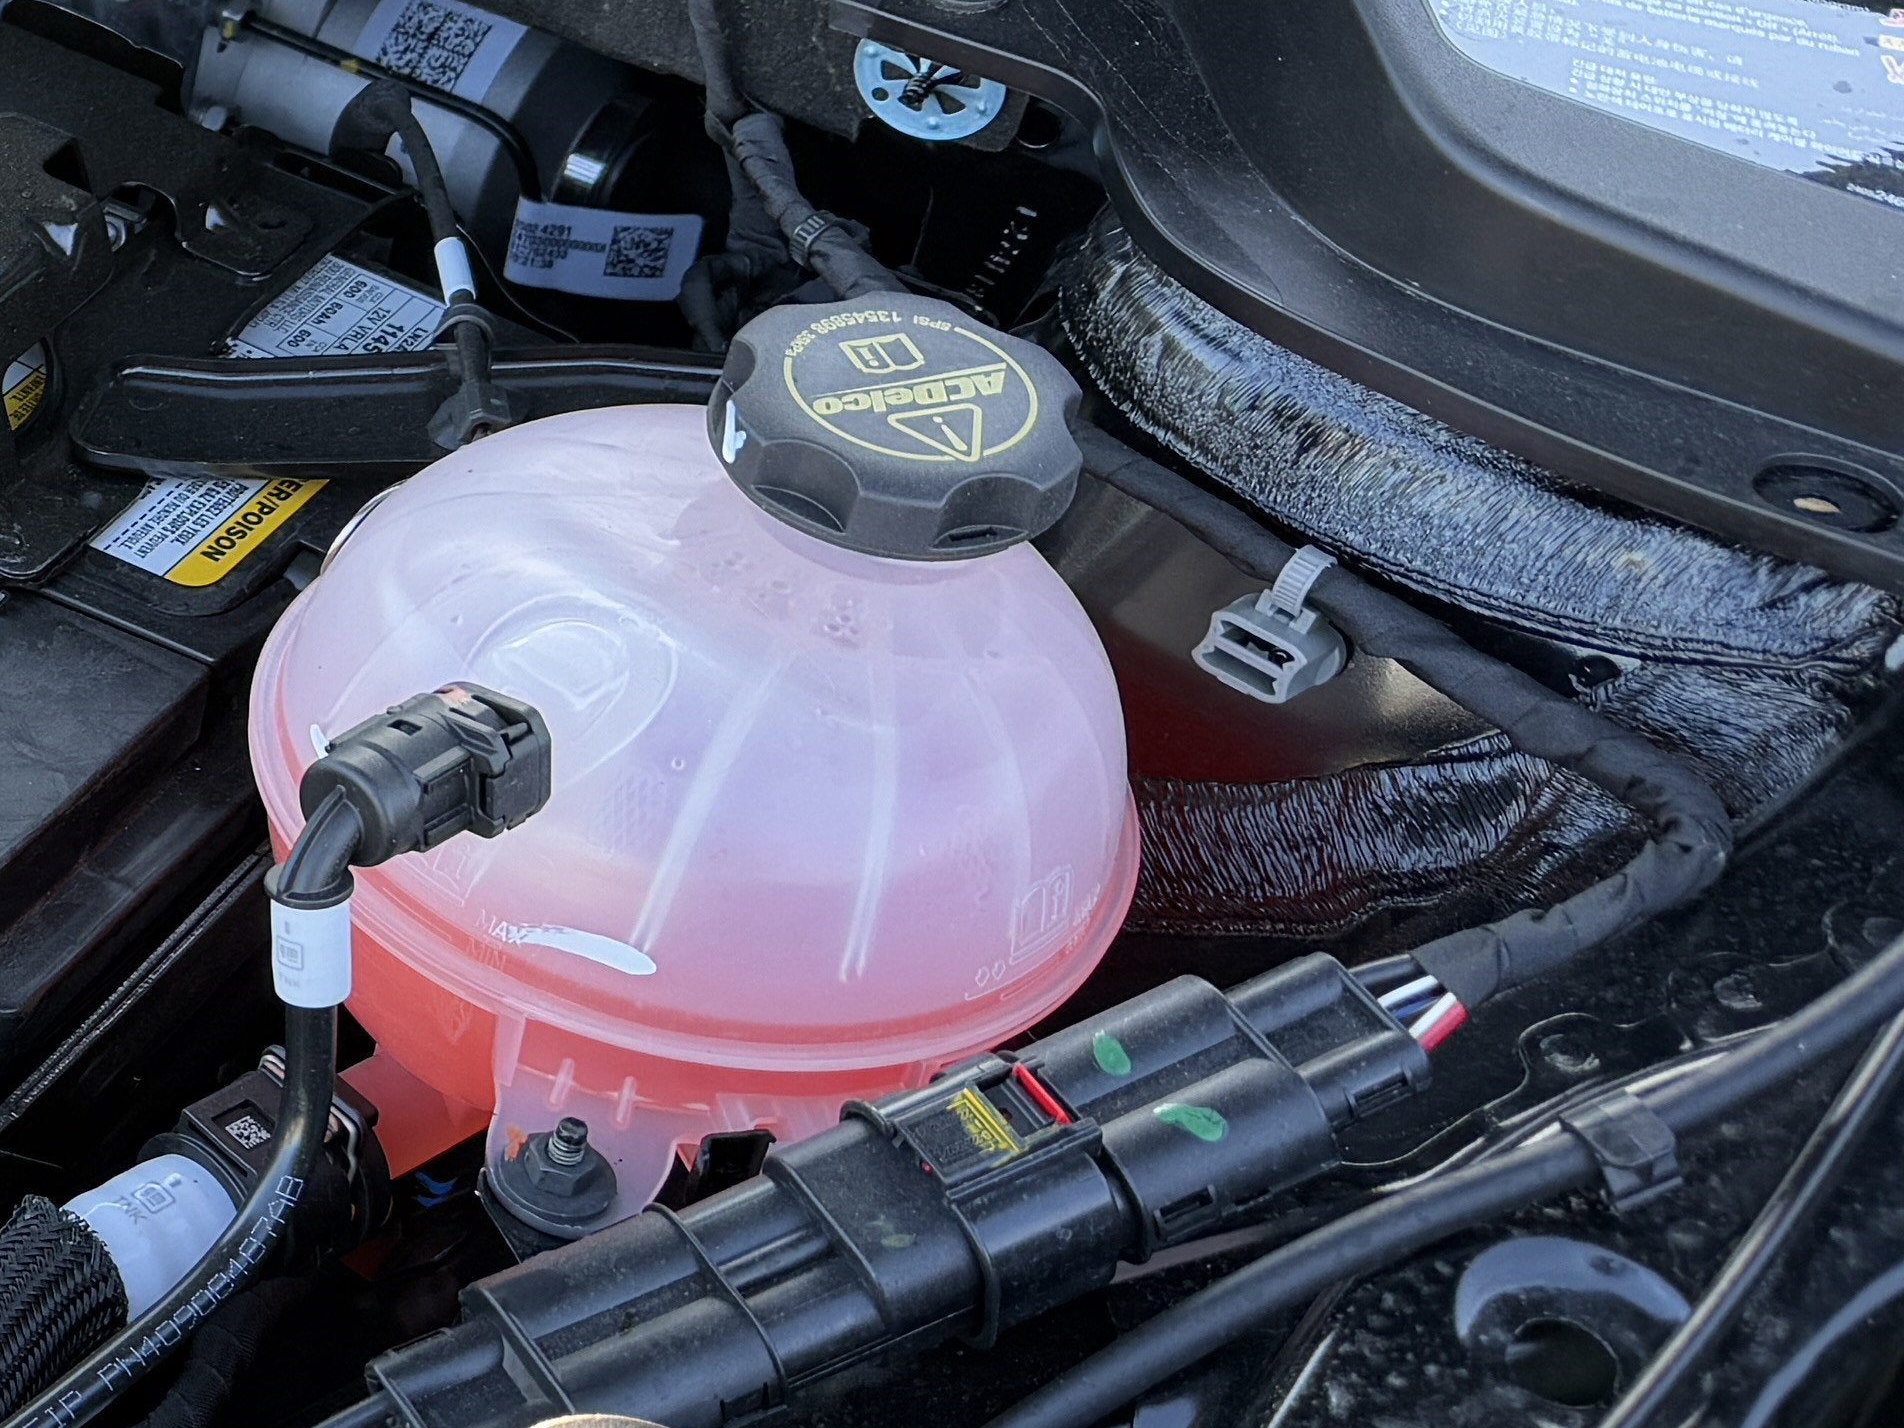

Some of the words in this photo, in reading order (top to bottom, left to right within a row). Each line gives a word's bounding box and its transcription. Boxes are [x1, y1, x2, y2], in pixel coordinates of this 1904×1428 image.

[319, 266, 355, 296] GENERAL
[341, 278, 368, 299] 600
[288, 292, 324, 323] MOTORS
[364, 305, 391, 325] 12V
[284, 327, 313, 349] 600
[332, 322, 371, 354] VRLA
[811, 370, 1006, 415] ACDelco
